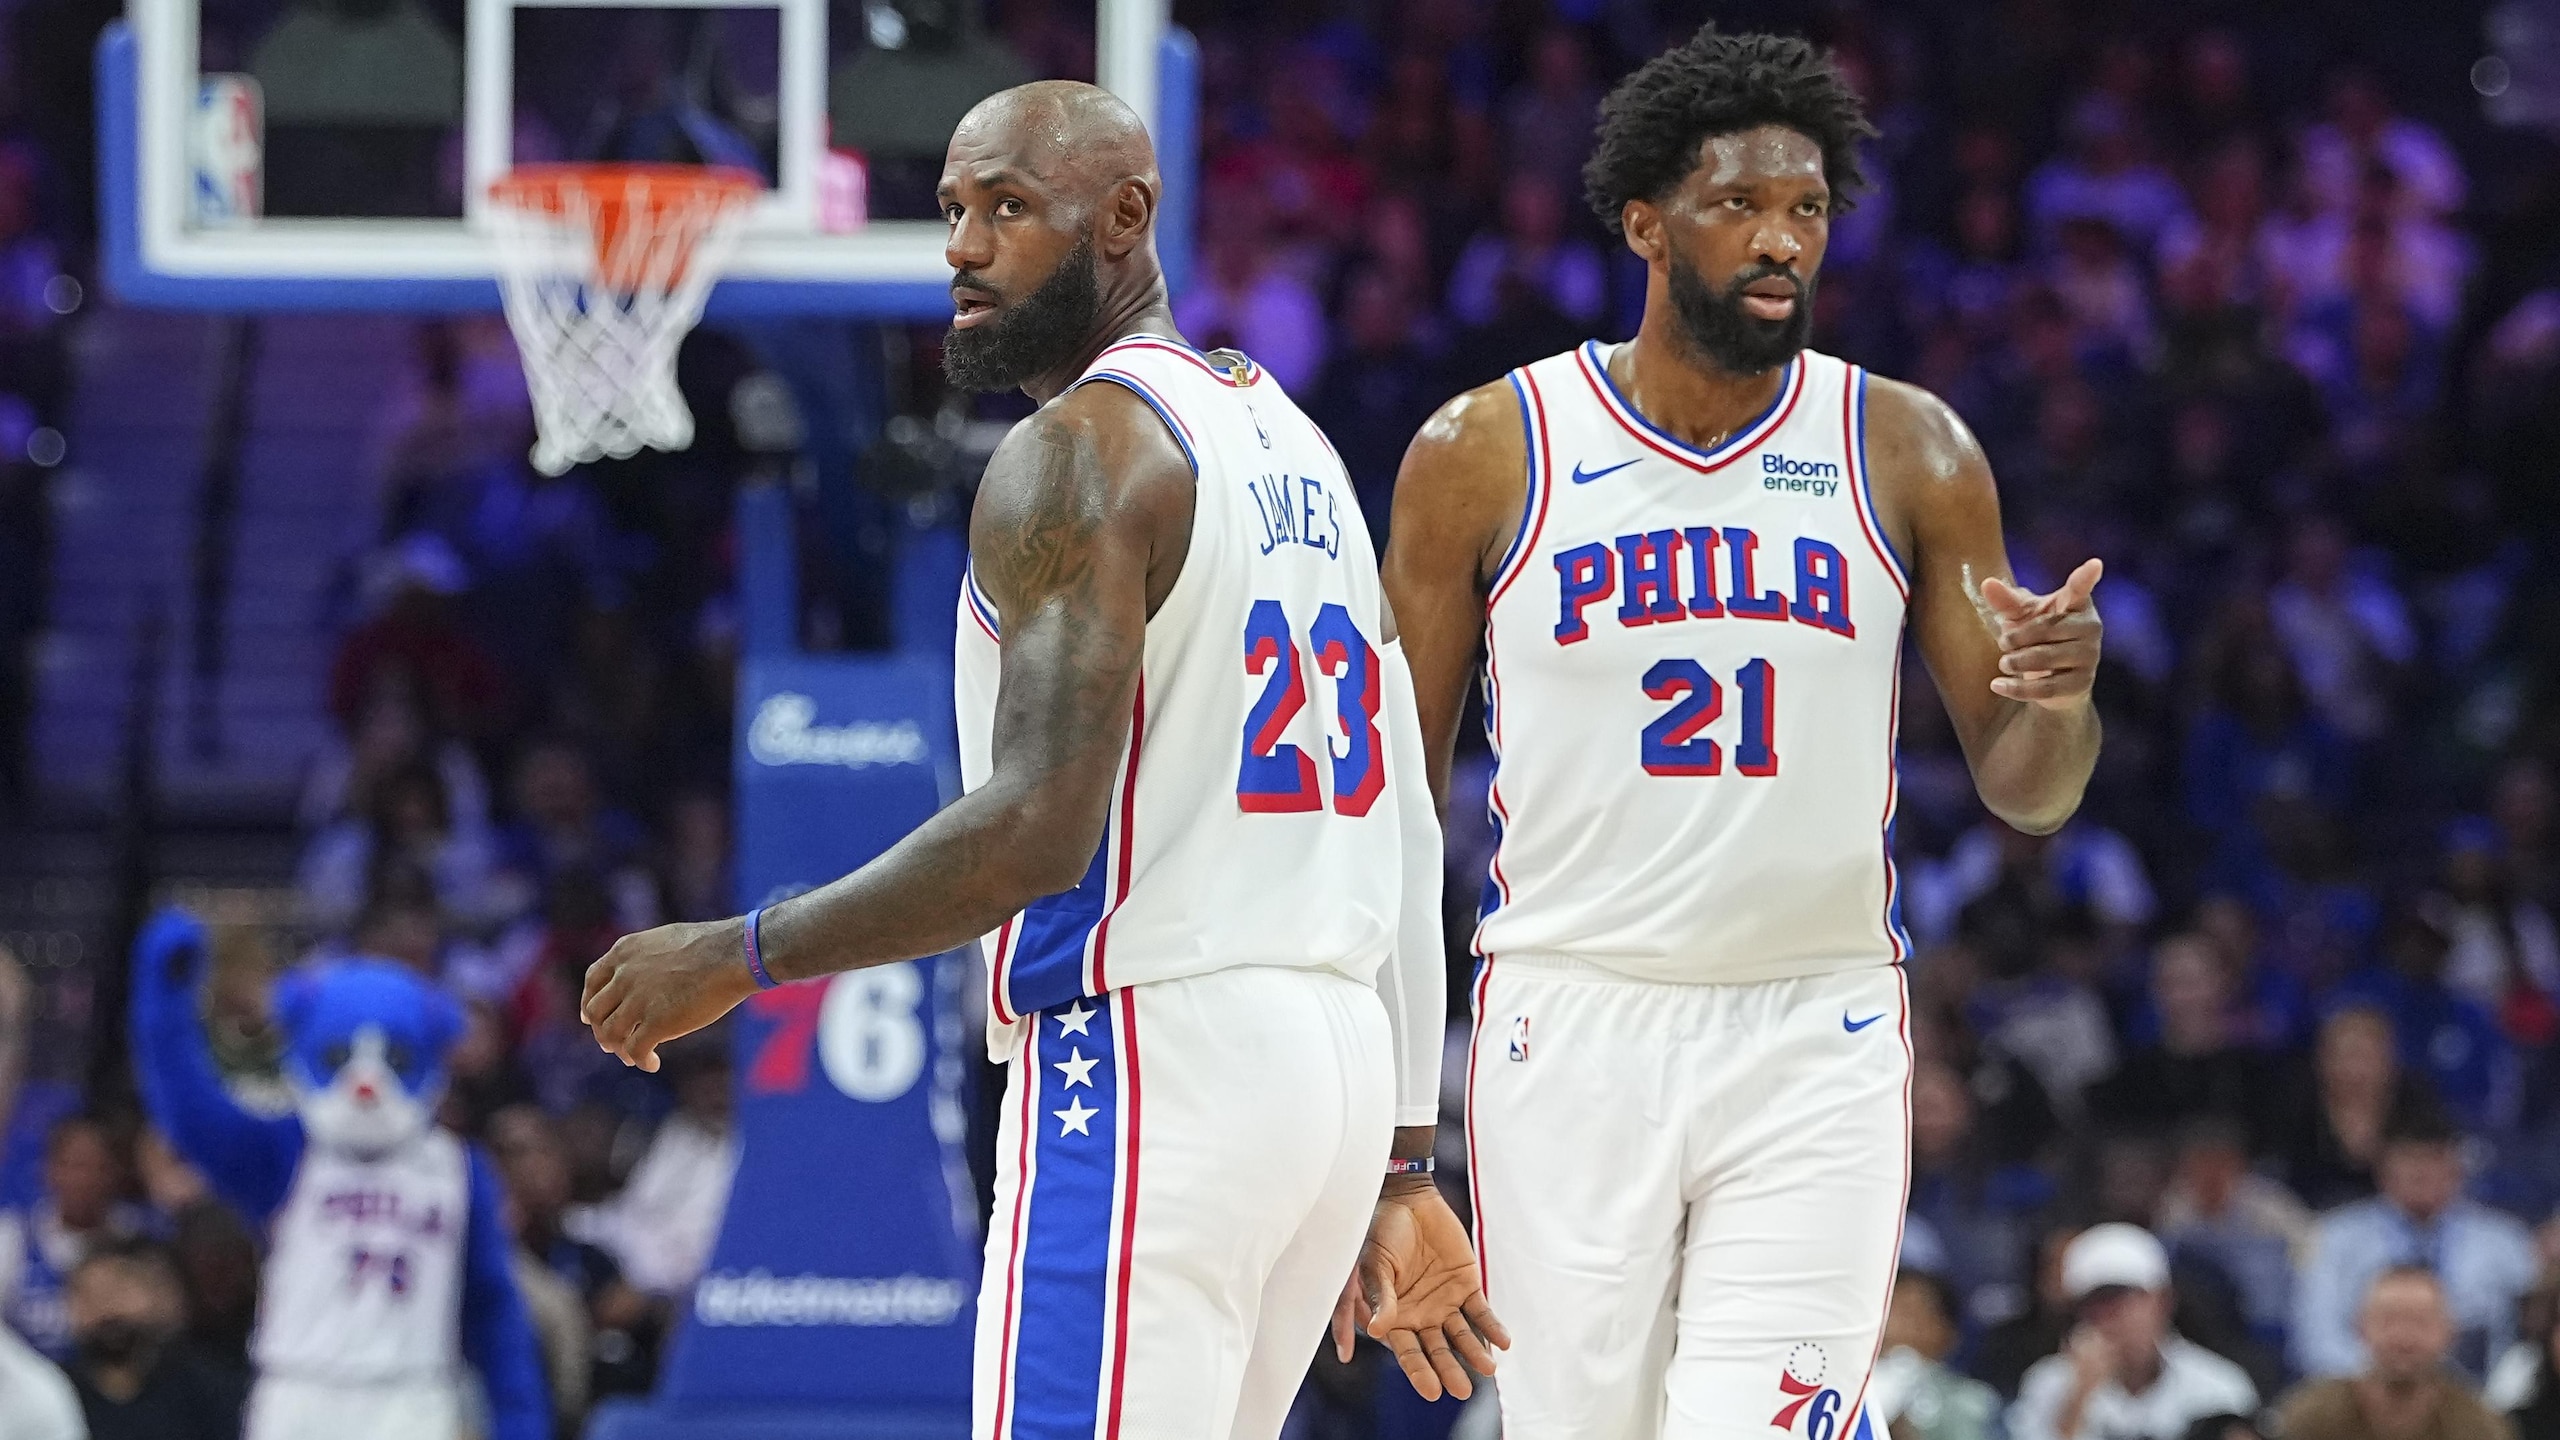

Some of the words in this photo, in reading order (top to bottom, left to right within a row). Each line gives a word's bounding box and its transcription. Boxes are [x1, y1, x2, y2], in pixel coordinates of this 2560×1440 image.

[1763, 454, 1838, 478] Bloom
[1764, 477, 1838, 497] energy
[1248, 474, 1340, 561] JAMES
[1554, 526, 1855, 647] PHILA
[1236, 600, 1385, 818] 23
[1641, 658, 1777, 776] 21
[748, 962, 929, 1103] 76
[1770, 1368, 1841, 1439] 76
